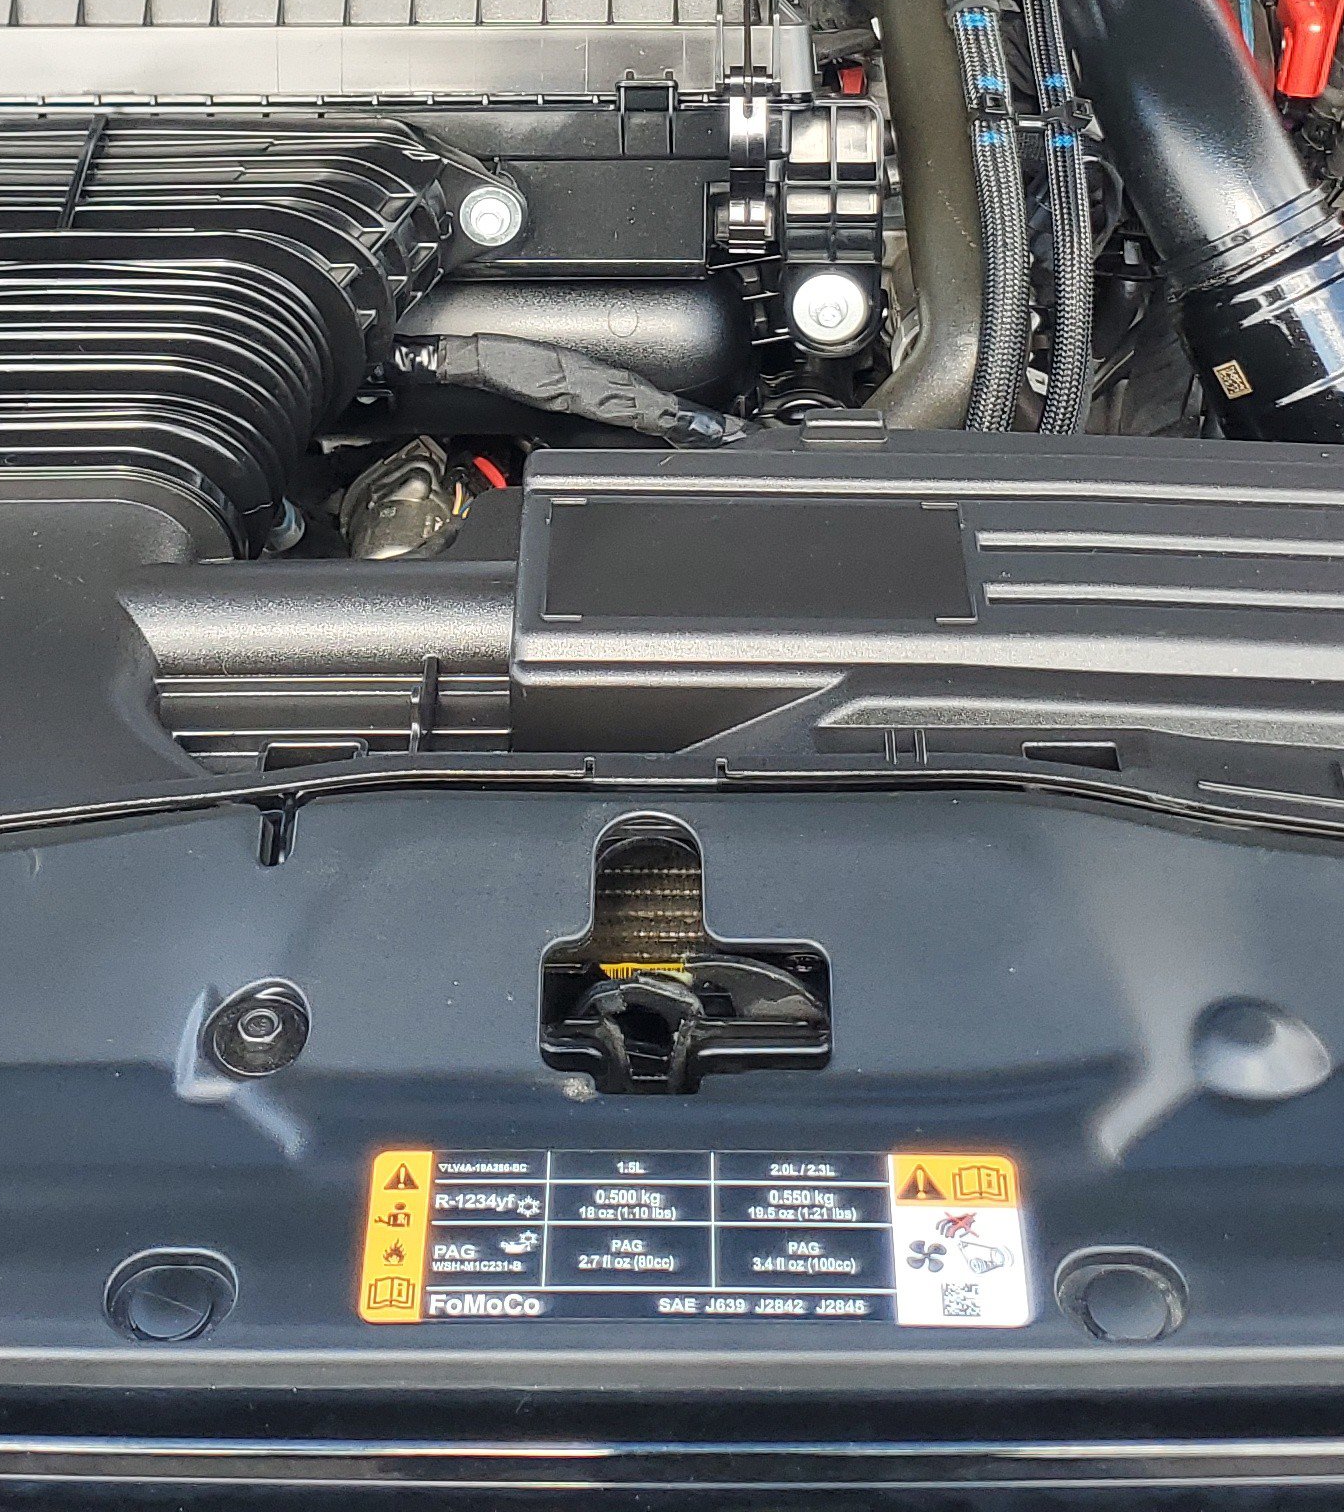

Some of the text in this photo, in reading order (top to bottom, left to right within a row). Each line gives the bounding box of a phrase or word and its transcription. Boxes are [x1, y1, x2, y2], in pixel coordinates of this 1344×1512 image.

[616, 1161, 645, 1173] 1.5L
[770, 1163, 798, 1176] 2.0L
[807, 1164, 836, 1176] 2.3L
[434, 1193, 516, 1212] R-1234yf
[595, 1189, 661, 1207] 0.500 kg
[769, 1189, 835, 1208] 0.550 kg
[579, 1206, 677, 1221] 18 oz (1.10 lbs)
[748, 1206, 857, 1221] 19.5 oz (1.21 lbs)
[432, 1244, 477, 1260] PAG
[611, 1239, 644, 1253] PAG
[788, 1241, 821, 1256] PAG
[431, 1260, 523, 1272] WSH-M1C231-B
[578, 1254, 675, 1271] 2.7 fl oz (80cc)
[752, 1257, 857, 1274] 3.4 fl oz (100cc)
[428, 1293, 541, 1316] FoMoCo
[658, 1297, 866, 1314] SAE J639 J2842 J2845
